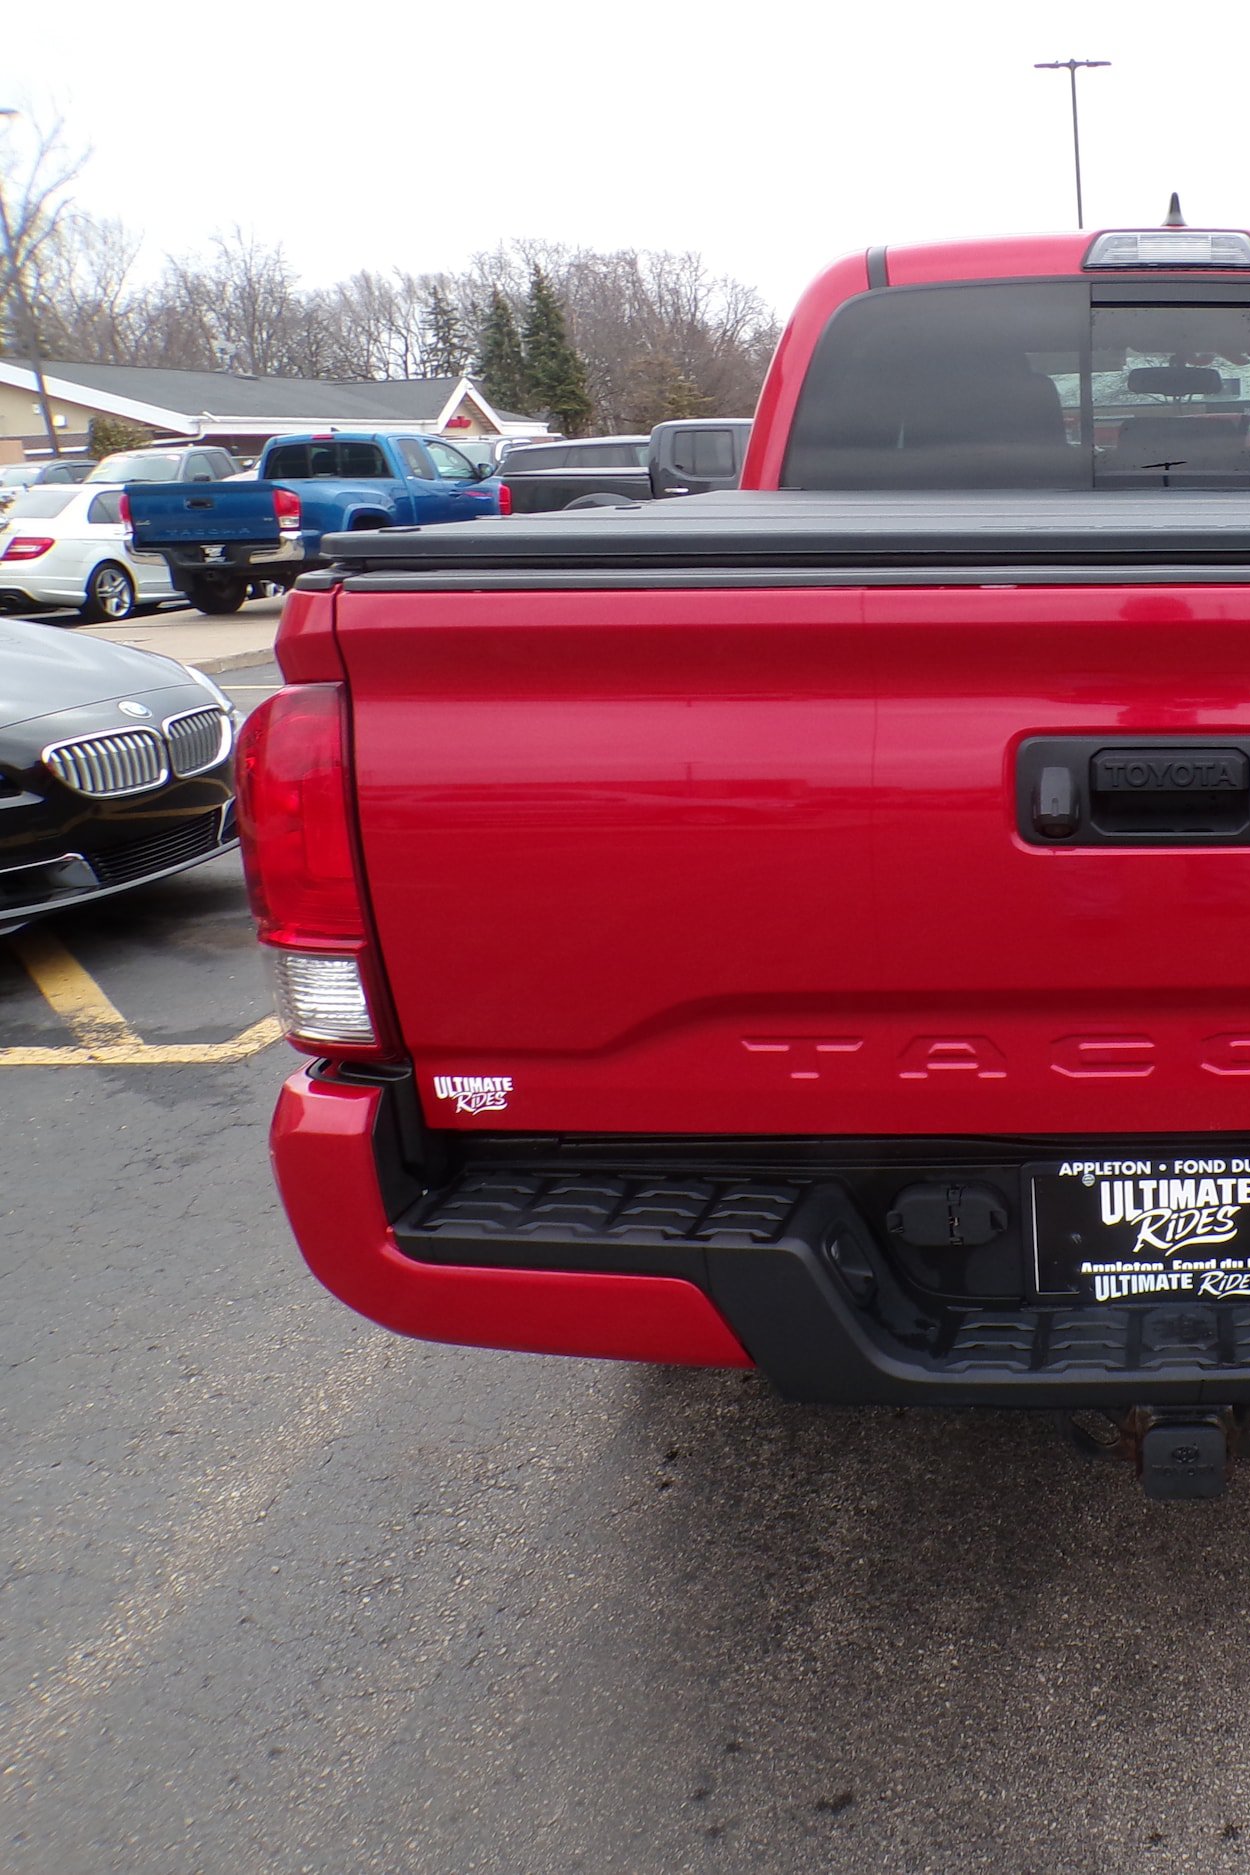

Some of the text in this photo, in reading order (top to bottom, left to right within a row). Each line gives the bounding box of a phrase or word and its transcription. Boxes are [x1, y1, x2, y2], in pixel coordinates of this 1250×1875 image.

[1105, 762, 1237, 787] TOYOTA
[433, 1076, 514, 1099] ULTIMATE
[1059, 1161, 1151, 1176] APPLETON
[1174, 1159, 1226, 1175] FOND
[1094, 1273, 1194, 1301] ULTIMATE
